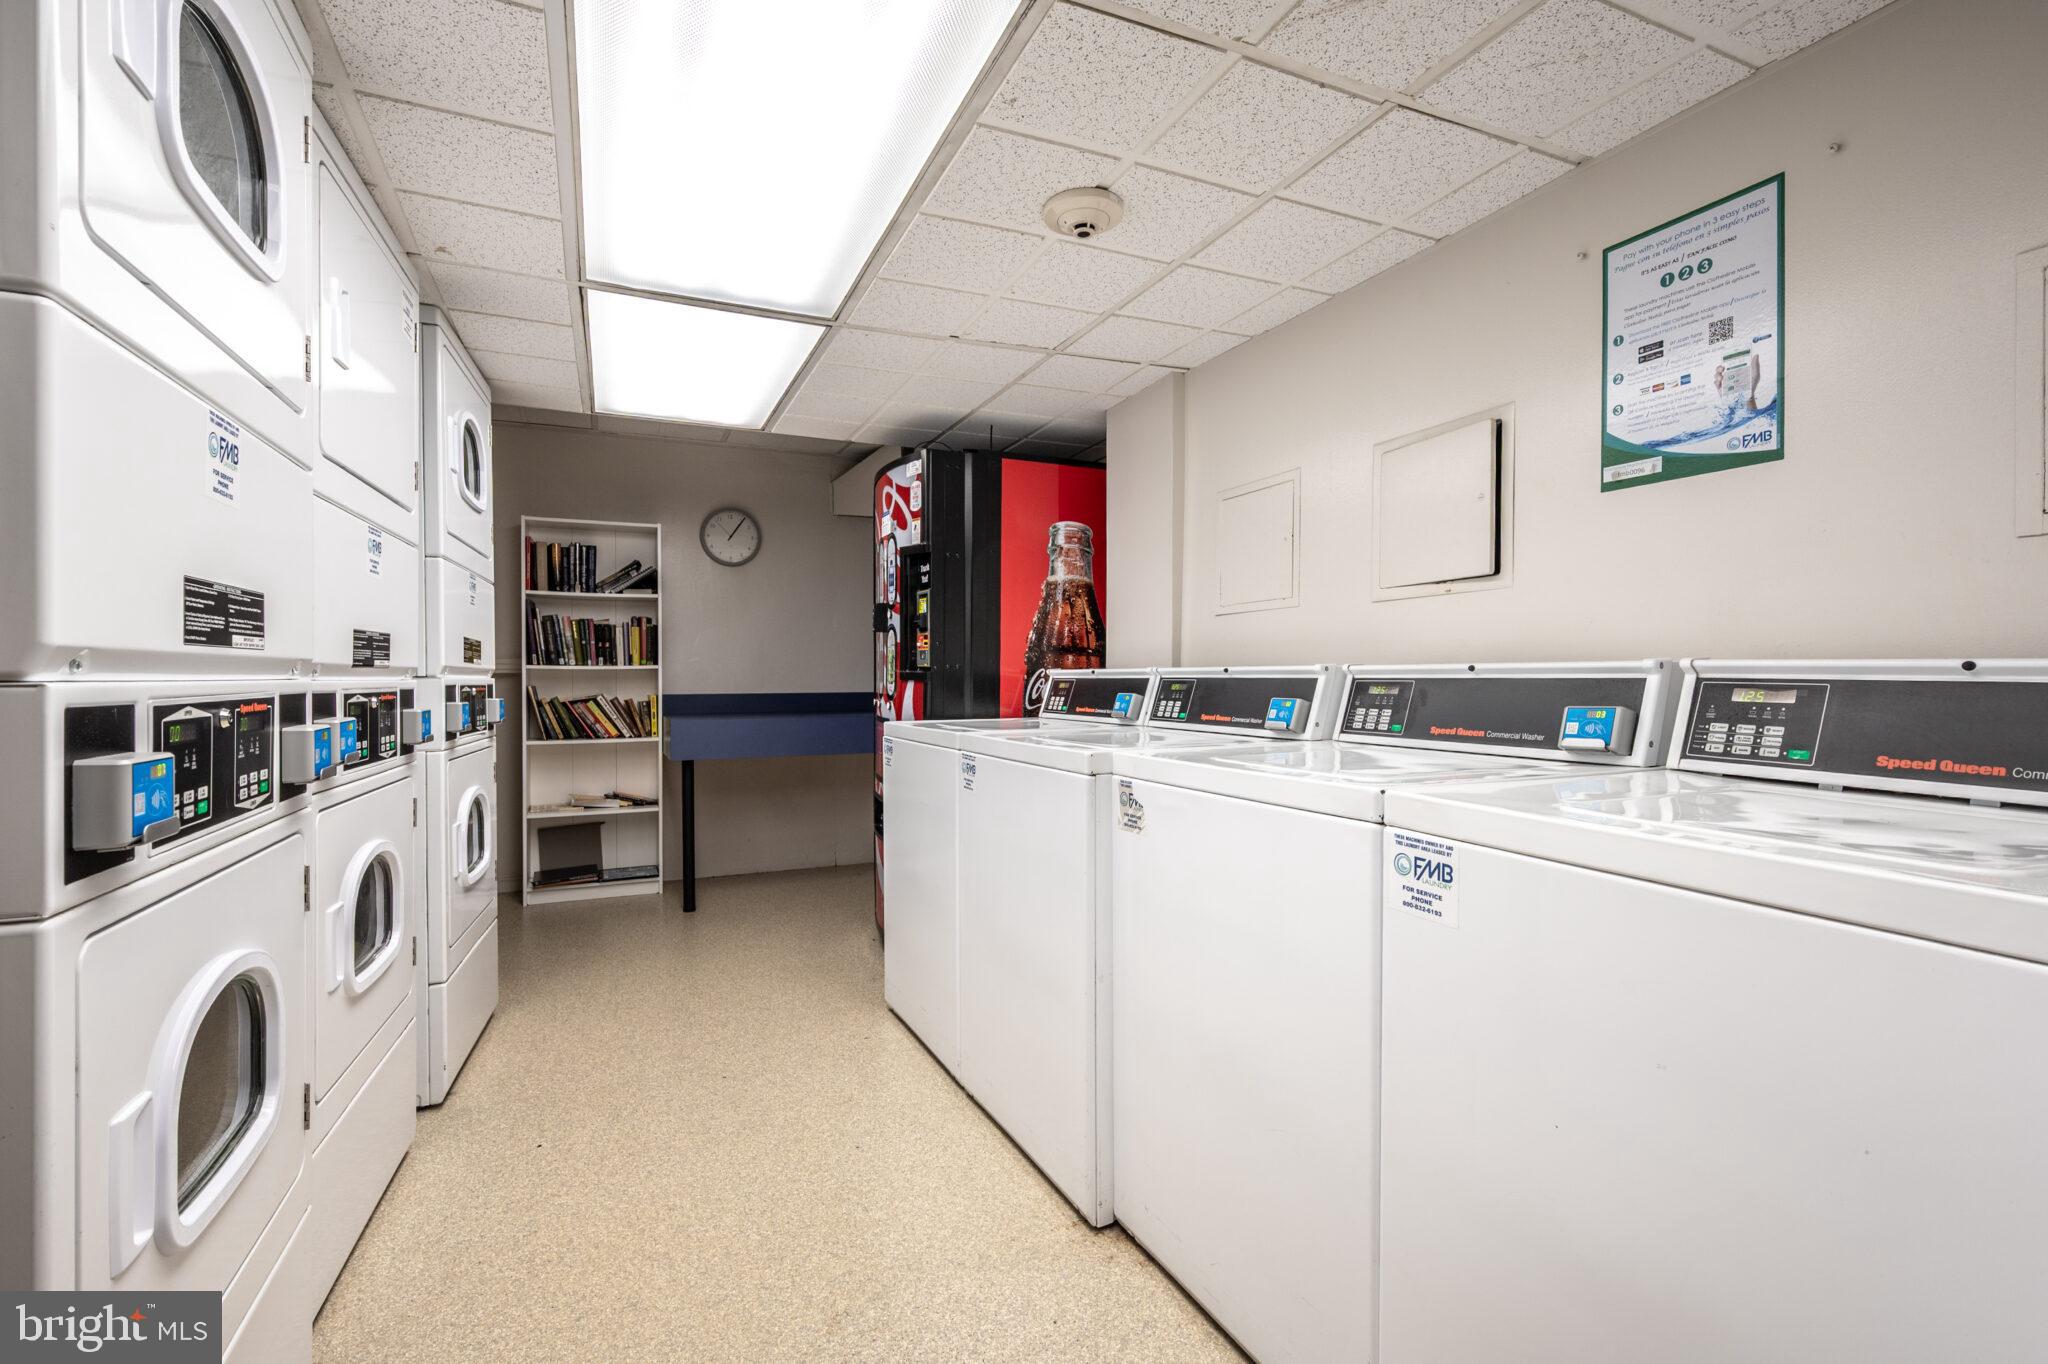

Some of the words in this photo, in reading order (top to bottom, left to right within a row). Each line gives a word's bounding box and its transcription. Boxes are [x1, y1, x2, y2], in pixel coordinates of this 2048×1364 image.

[1623, 252, 1637, 260] Pay
[1639, 244, 1654, 254] with
[1656, 237, 1673, 248] your
[1674, 224, 1701, 240] phone
[1703, 220, 1710, 228] in
[1712, 217, 1717, 225] 3
[1720, 209, 1740, 220] easy
[1742, 198, 1766, 212] steps
[1659, 261, 1671, 270] EASY
[1742, 430, 1773, 449] FMB
[219, 436, 239, 466] FMB
[1430, 726, 1457, 736] Speed
[1457, 728, 1485, 737] Queen
[1486, 730, 1521, 740] Commercial
[1522, 732, 1545, 741] Washer
[1875, 755, 1937, 771] Speed
[1939, 759, 2007, 777] Queen
[2012, 767, 2048, 780] Com
[1413, 856, 1454, 884] FMB
[1402, 884, 1415, 893] FOR
[1416, 888, 1443, 901] SERVICE
[1422, 879, 1453, 891] LAUNDRY
[1411, 895, 1433, 906] PHONE
